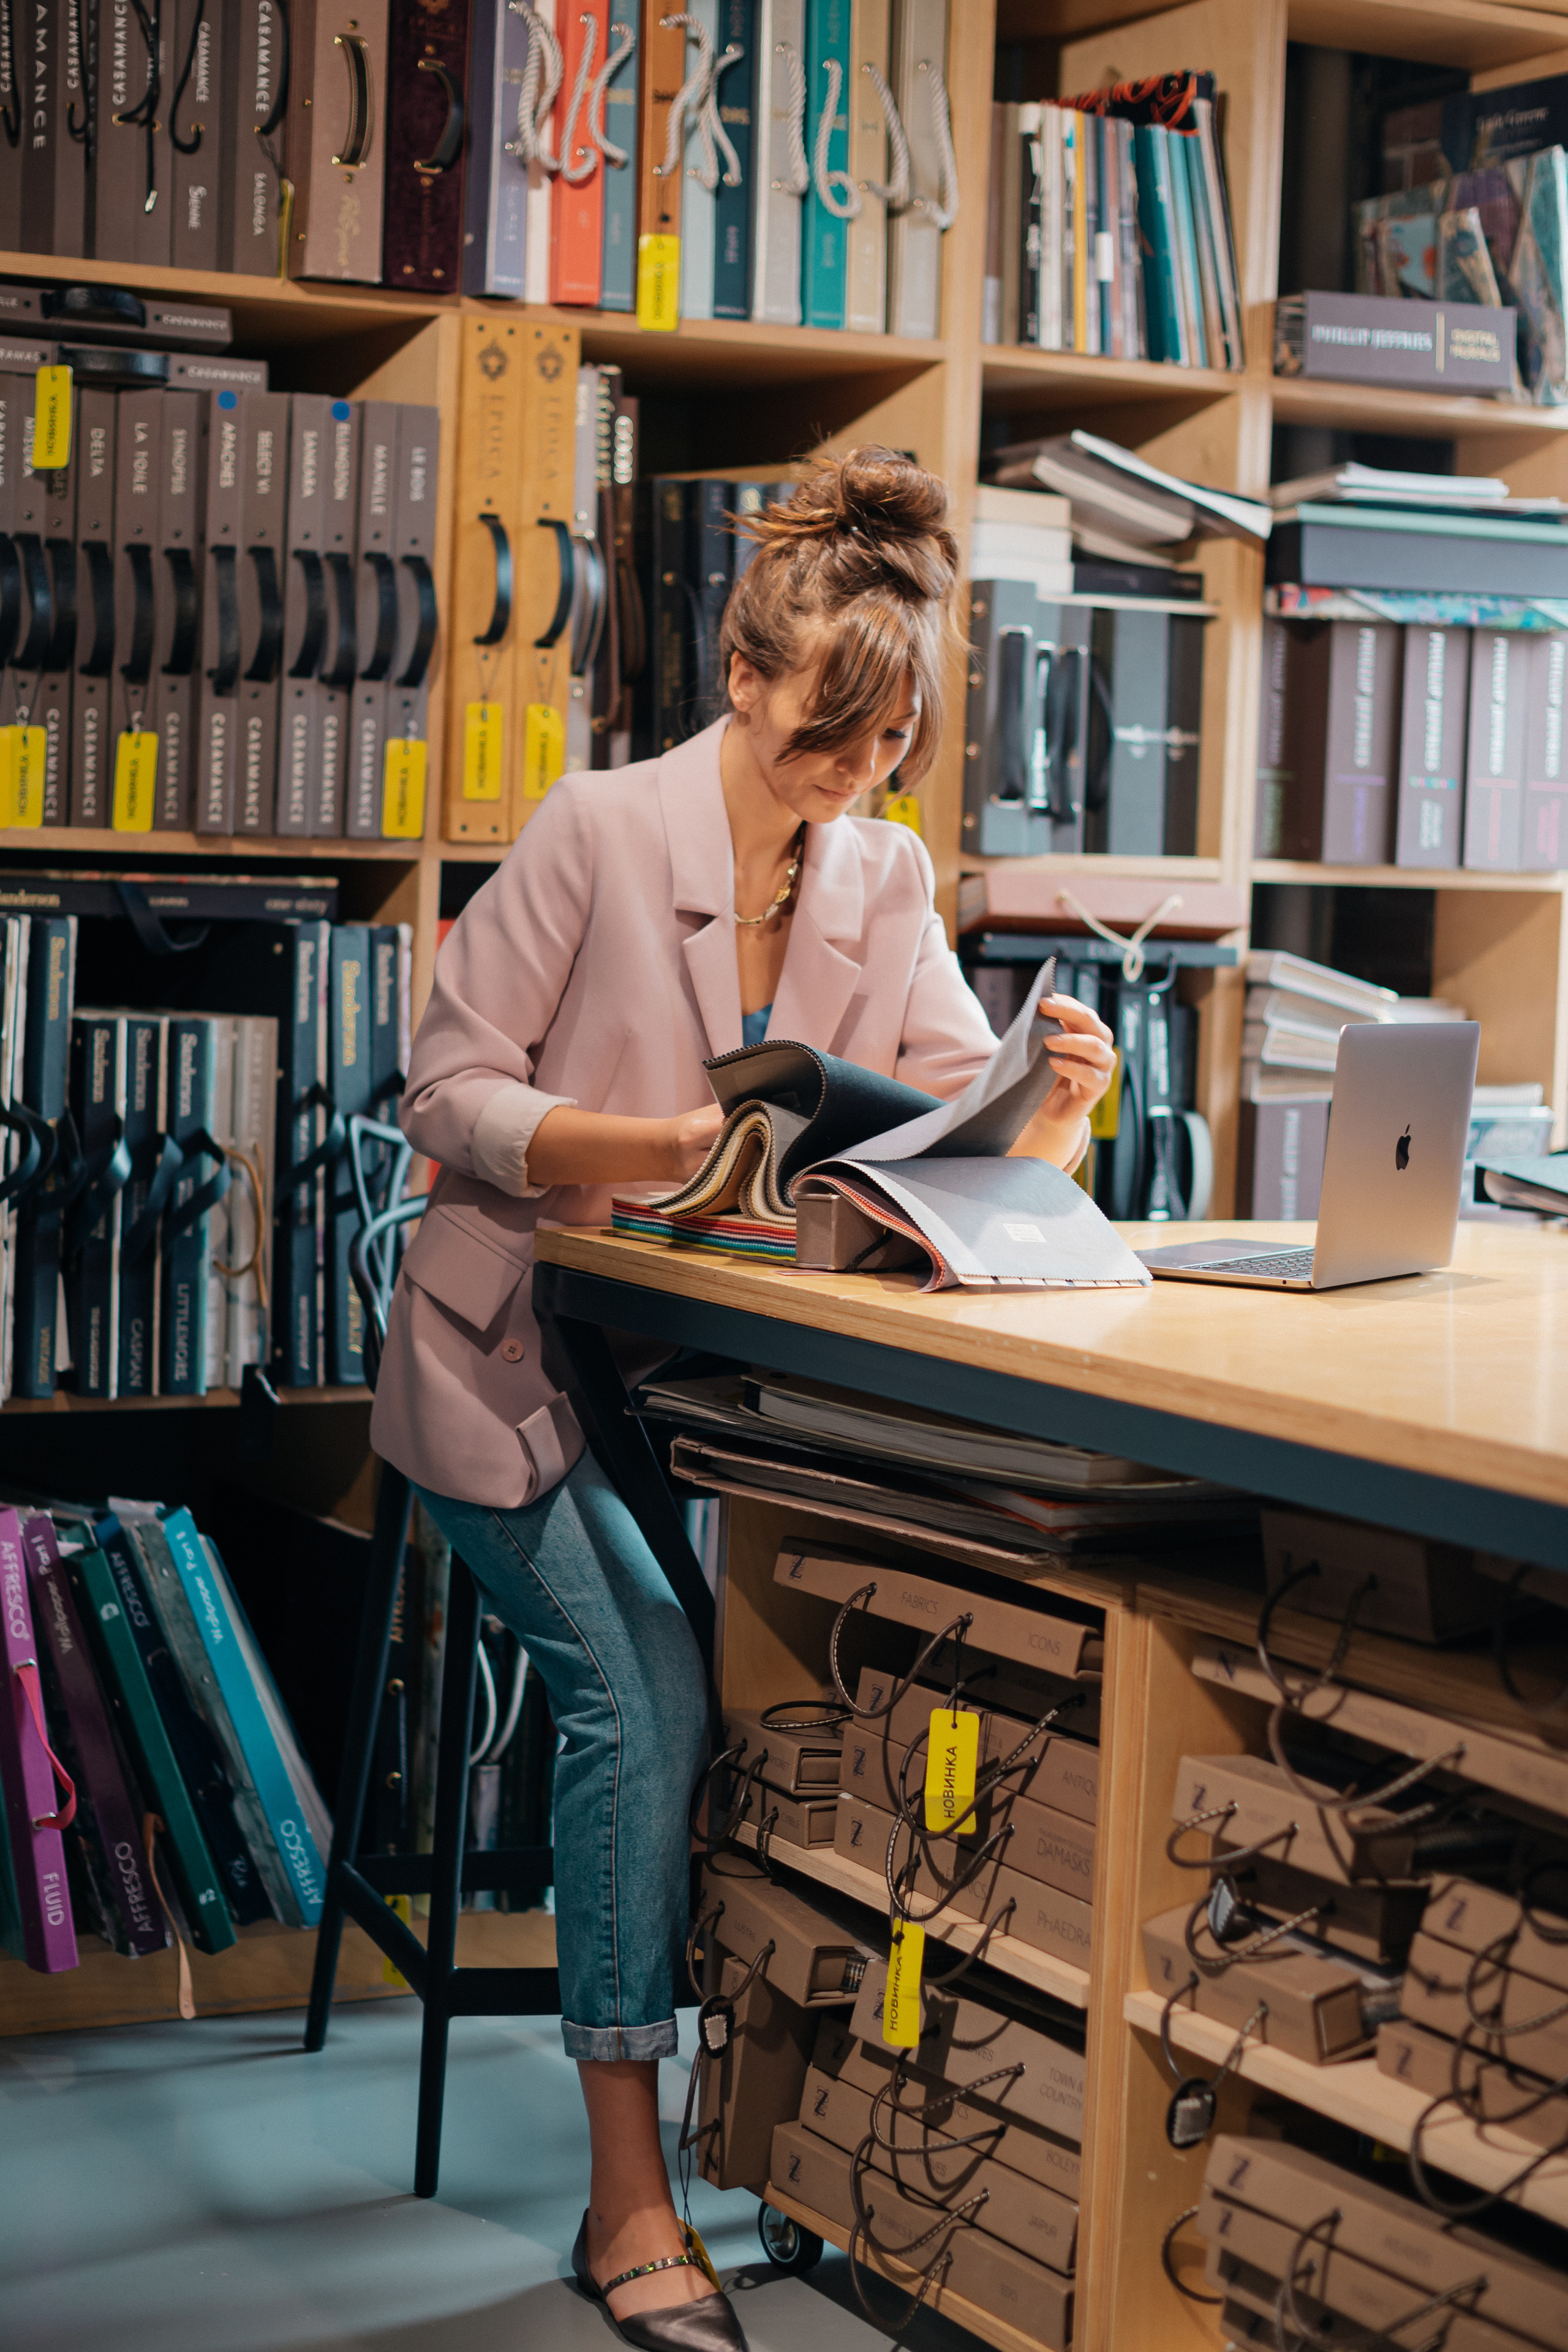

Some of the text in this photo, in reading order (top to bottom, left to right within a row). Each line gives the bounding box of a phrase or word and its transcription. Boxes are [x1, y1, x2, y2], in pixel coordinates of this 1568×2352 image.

[112, 0, 127, 106] CASAMANC
[255, 0, 272, 113] CASAMANCE
[89, 428, 105, 478] DELTA
[0, 888, 60, 908] anderson
[901, 1591, 938, 1615] FABRICS
[944, 1745, 958, 1819] НОВИНКА
[115, 1841, 156, 1933] AFFRESCO
[280, 1819, 325, 1905] AFFRESCO
[1036, 1837, 1091, 1877] DAMASKS
[42, 1871, 65, 1926] FLUID
[889, 1954, 903, 2031] НОВИНКА
[1050, 2067, 1076, 2089] TOWN
